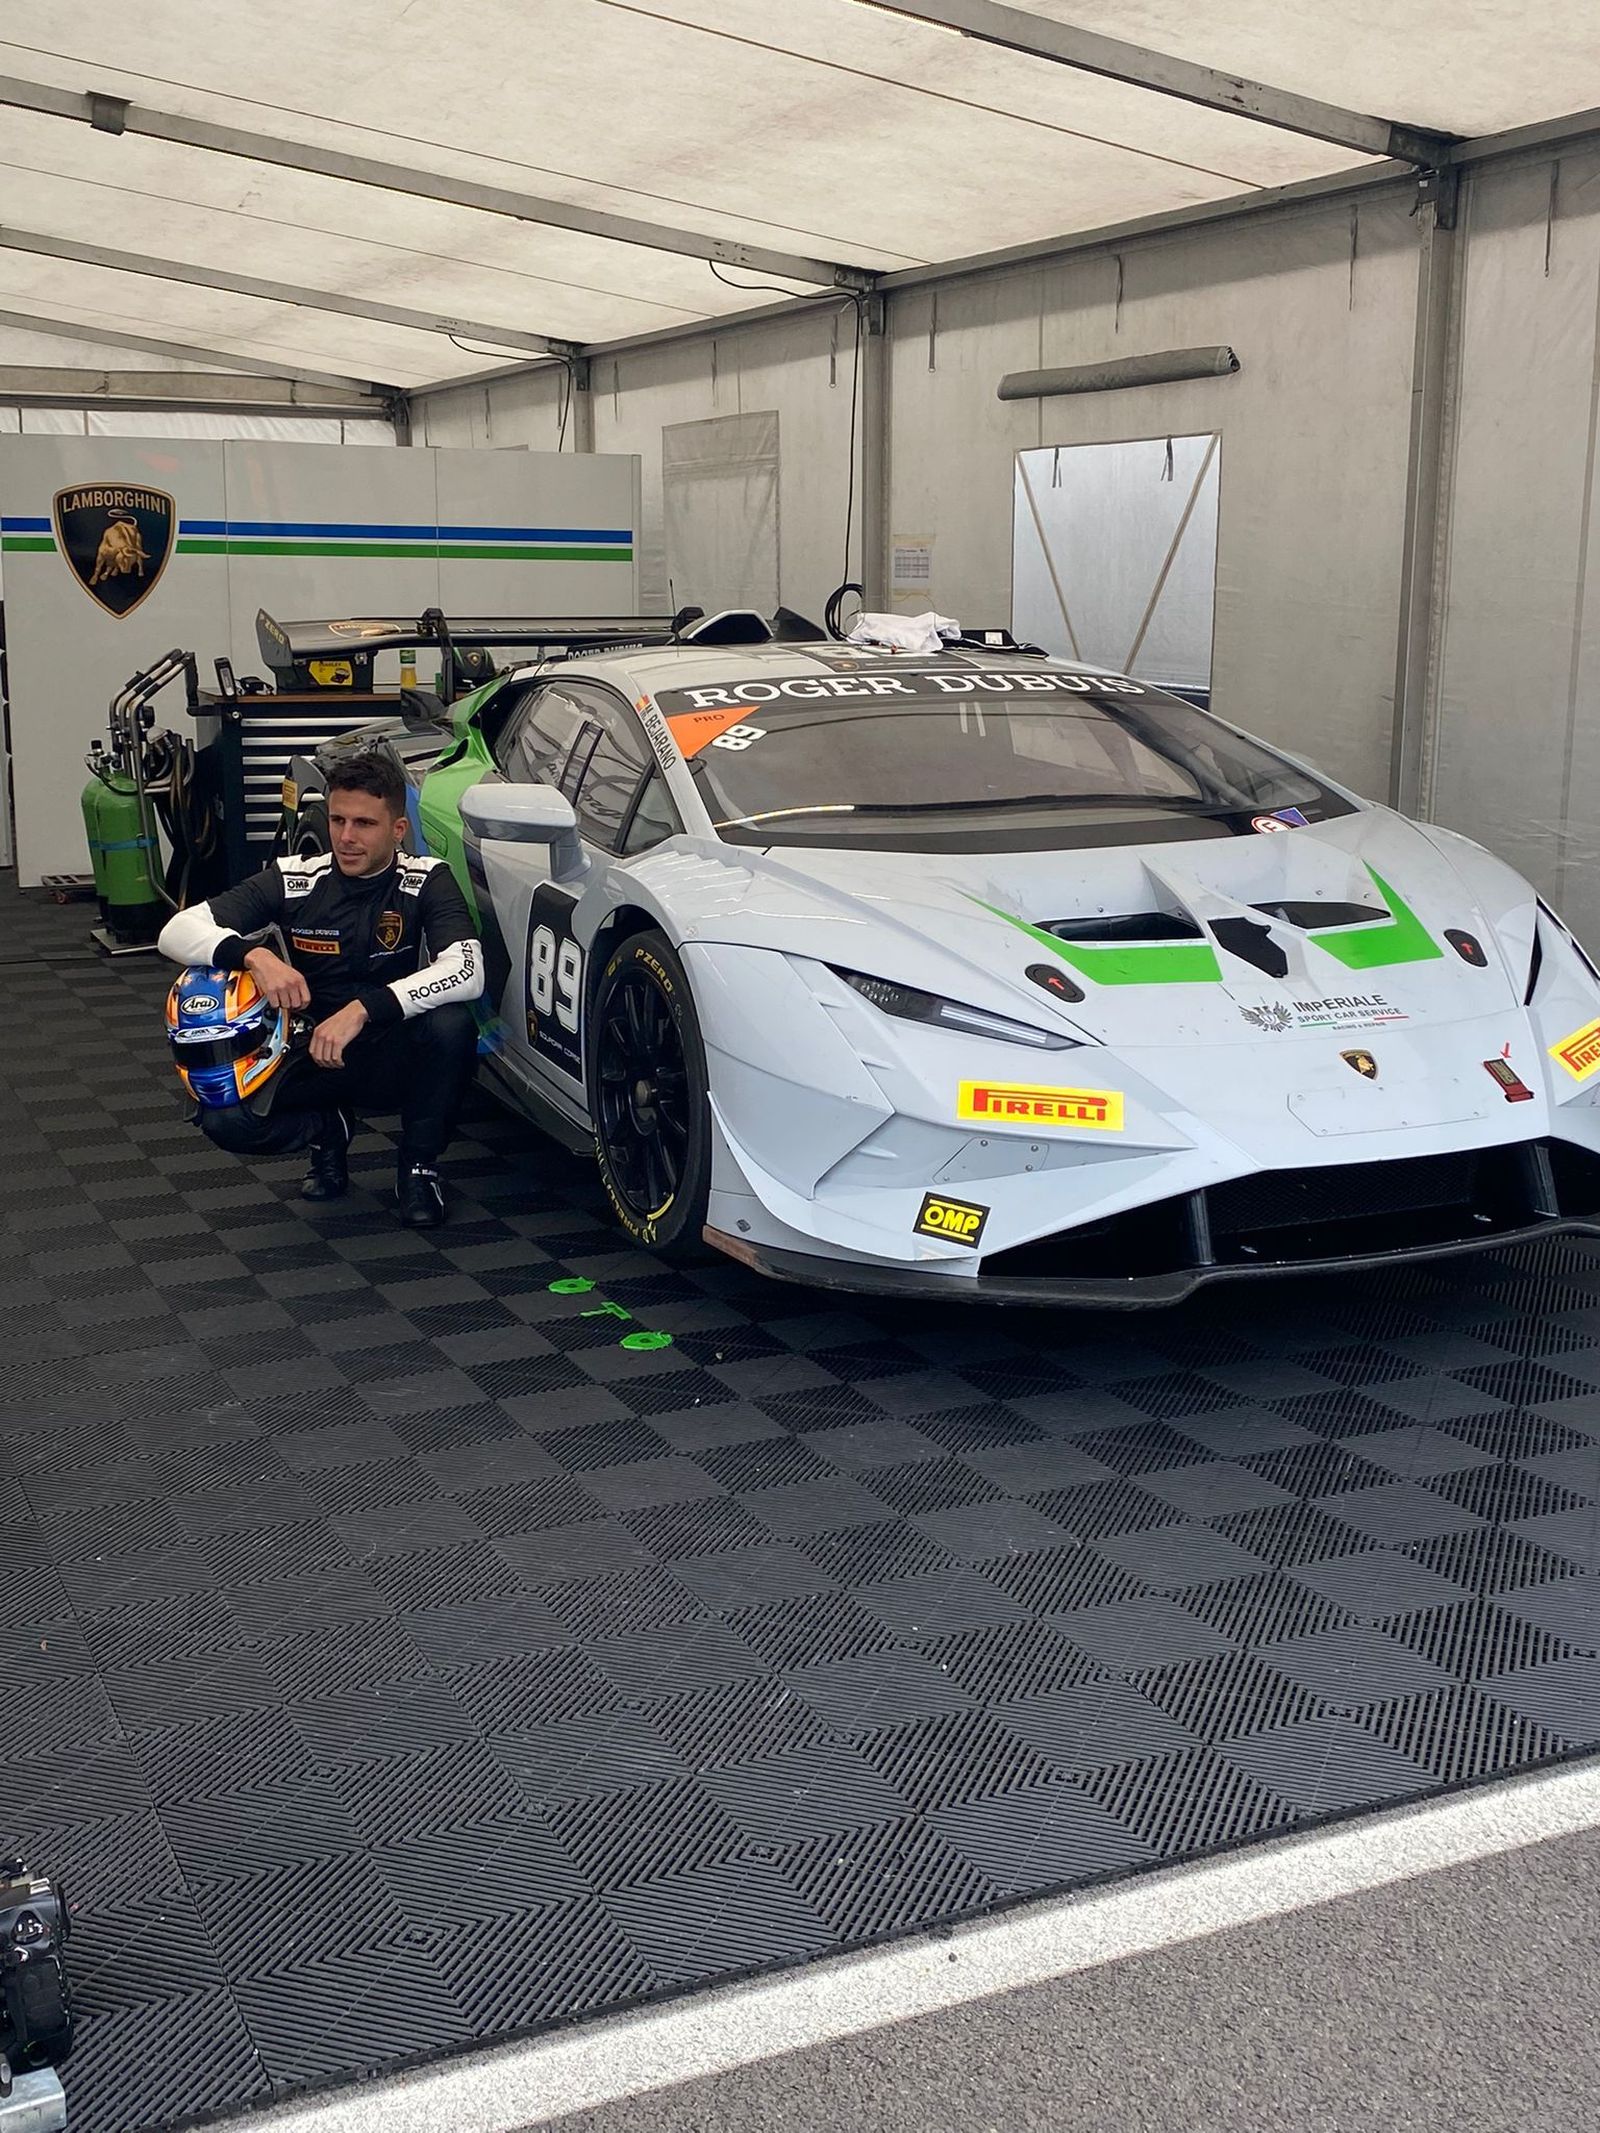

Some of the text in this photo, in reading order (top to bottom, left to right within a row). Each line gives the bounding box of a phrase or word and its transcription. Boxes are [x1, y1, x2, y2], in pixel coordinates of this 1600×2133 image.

[63, 490, 166, 515] LAMBORGHINI
[684, 674, 1145, 708] ROGER DUBUIS
[693, 714, 725, 723] PRO
[645, 713, 676, 771] BEJARANO
[712, 724, 768, 752] 89
[287, 880, 309, 889] OMP
[402, 876, 423, 887] OMP
[407, 974, 462, 1001] ROGER
[531, 924, 582, 1034] 89
[183, 998, 212, 1010] Arai
[1293, 994, 1388, 1013] IMPERIALE
[1297, 1007, 1402, 1023] SPORT CAR SERVICE
[1559, 1026, 1600, 1072] PIRE
[973, 1088, 1108, 1121] PIRELLI
[924, 1205, 980, 1234] OMP
